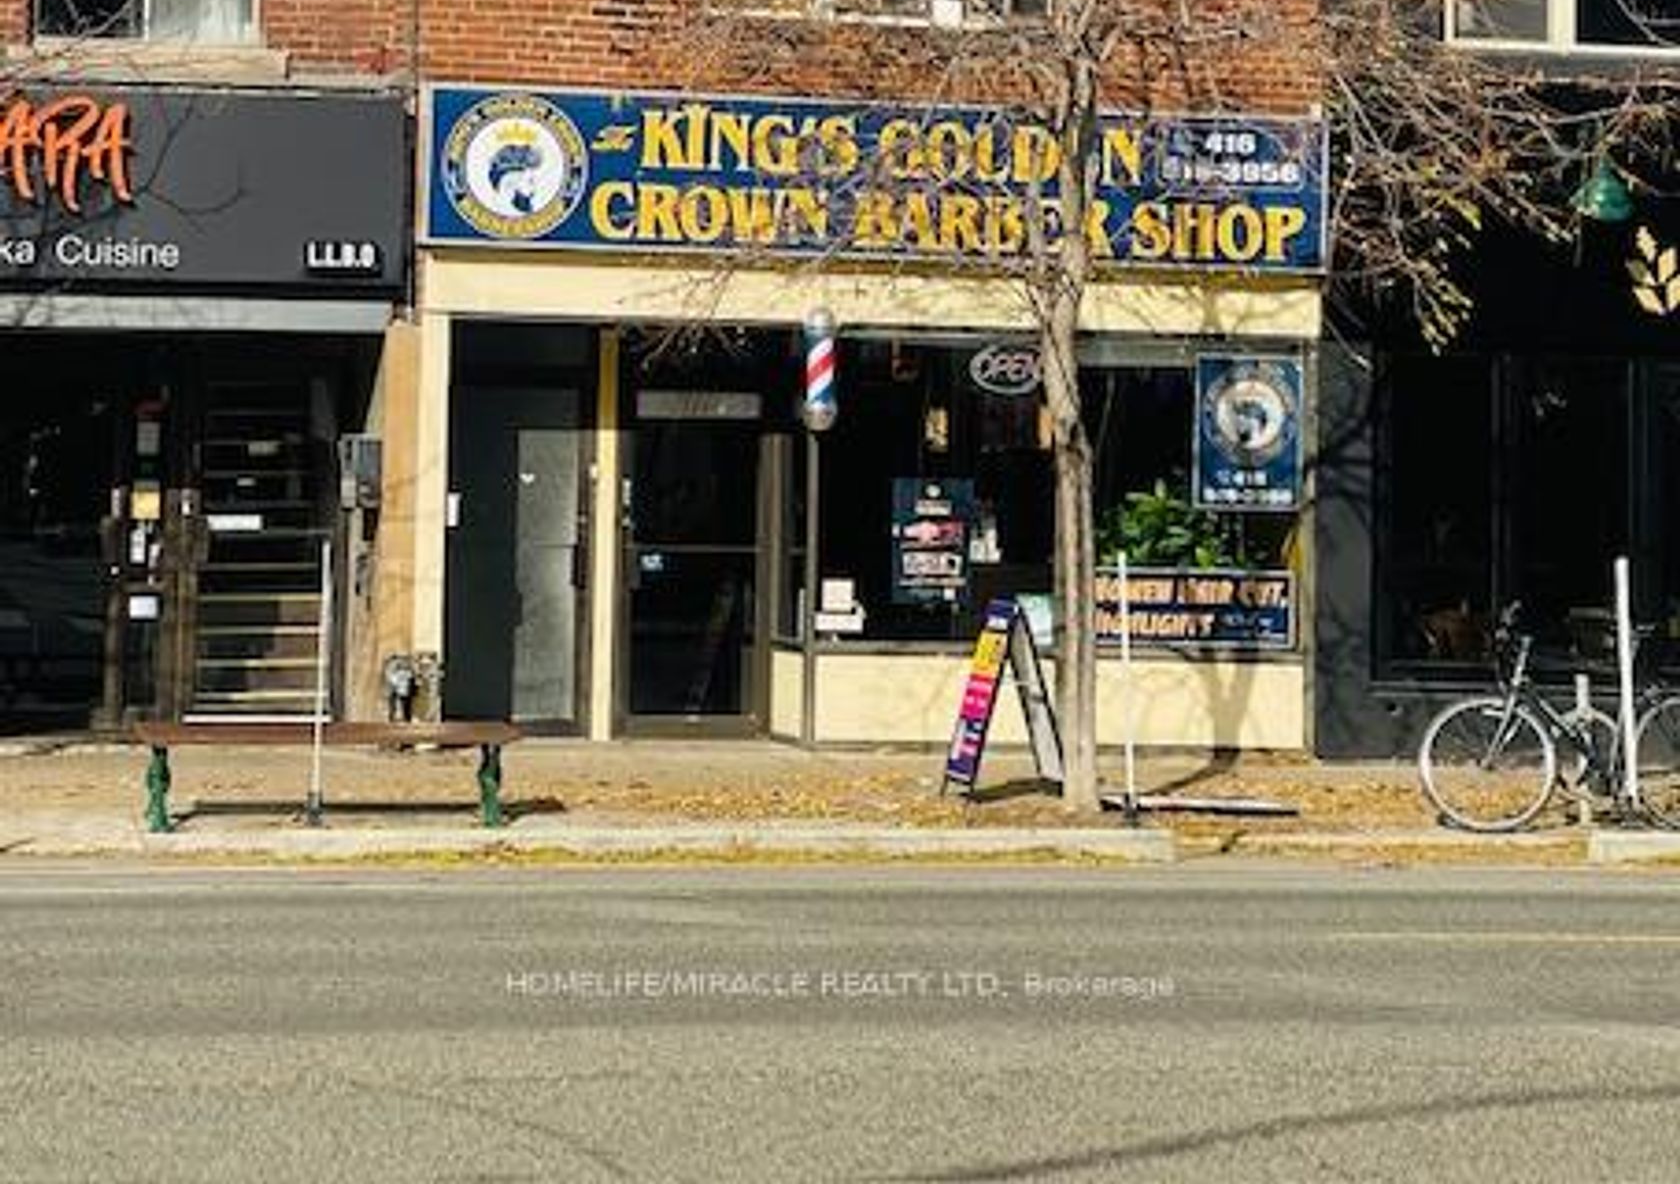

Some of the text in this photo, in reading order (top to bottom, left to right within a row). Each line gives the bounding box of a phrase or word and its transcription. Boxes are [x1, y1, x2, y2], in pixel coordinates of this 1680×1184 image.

[640, 104, 860, 178] KING'S
[876, 119, 1142, 186] GOLDN
[1205, 132, 1257, 154] 416
[590, 182, 829, 243] CROWN
[1131, 200, 1308, 262] SHOP
[55, 236, 180, 268] Cuisine
